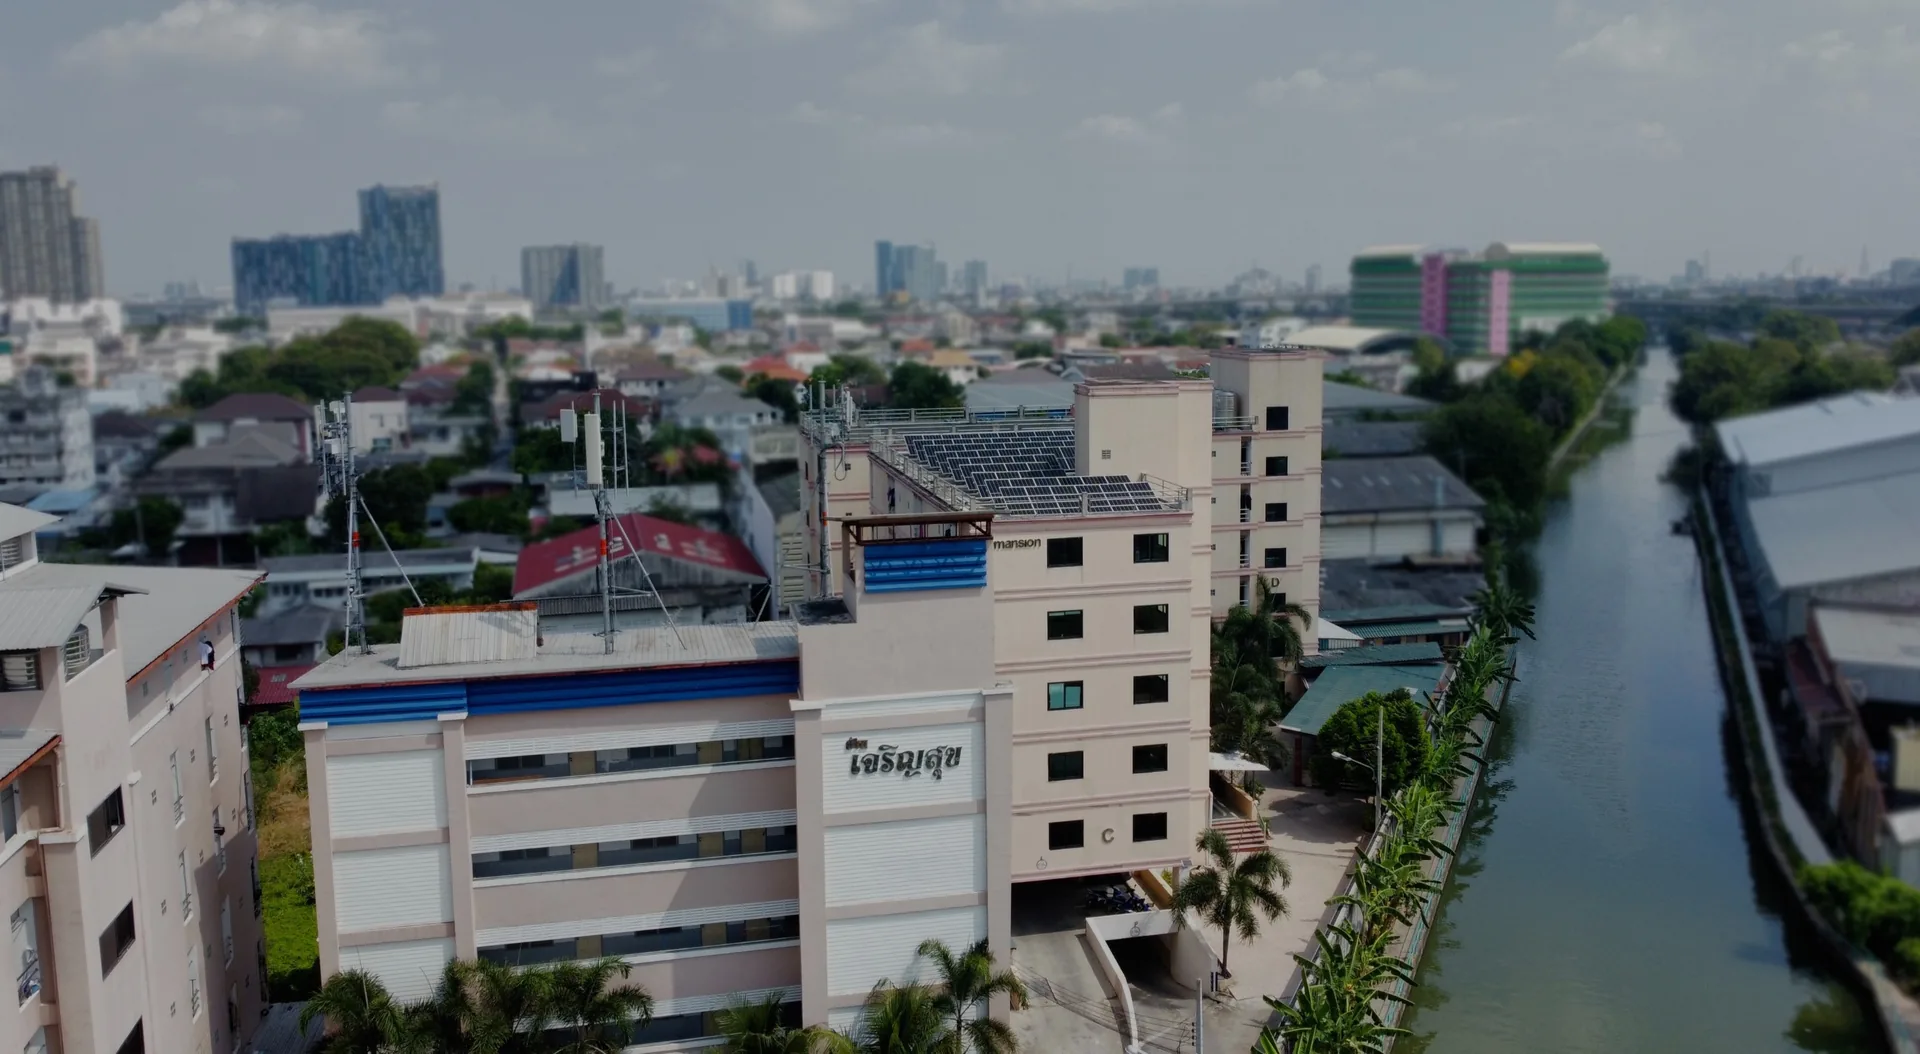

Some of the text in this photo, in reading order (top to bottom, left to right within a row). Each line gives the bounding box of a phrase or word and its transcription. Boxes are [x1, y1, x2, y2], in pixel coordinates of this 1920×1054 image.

[993, 538, 1041, 549] mansion
[1271, 577, 1280, 588] D
[851, 744, 962, 780] เจริญสุข
[1101, 828, 1115, 844] C
